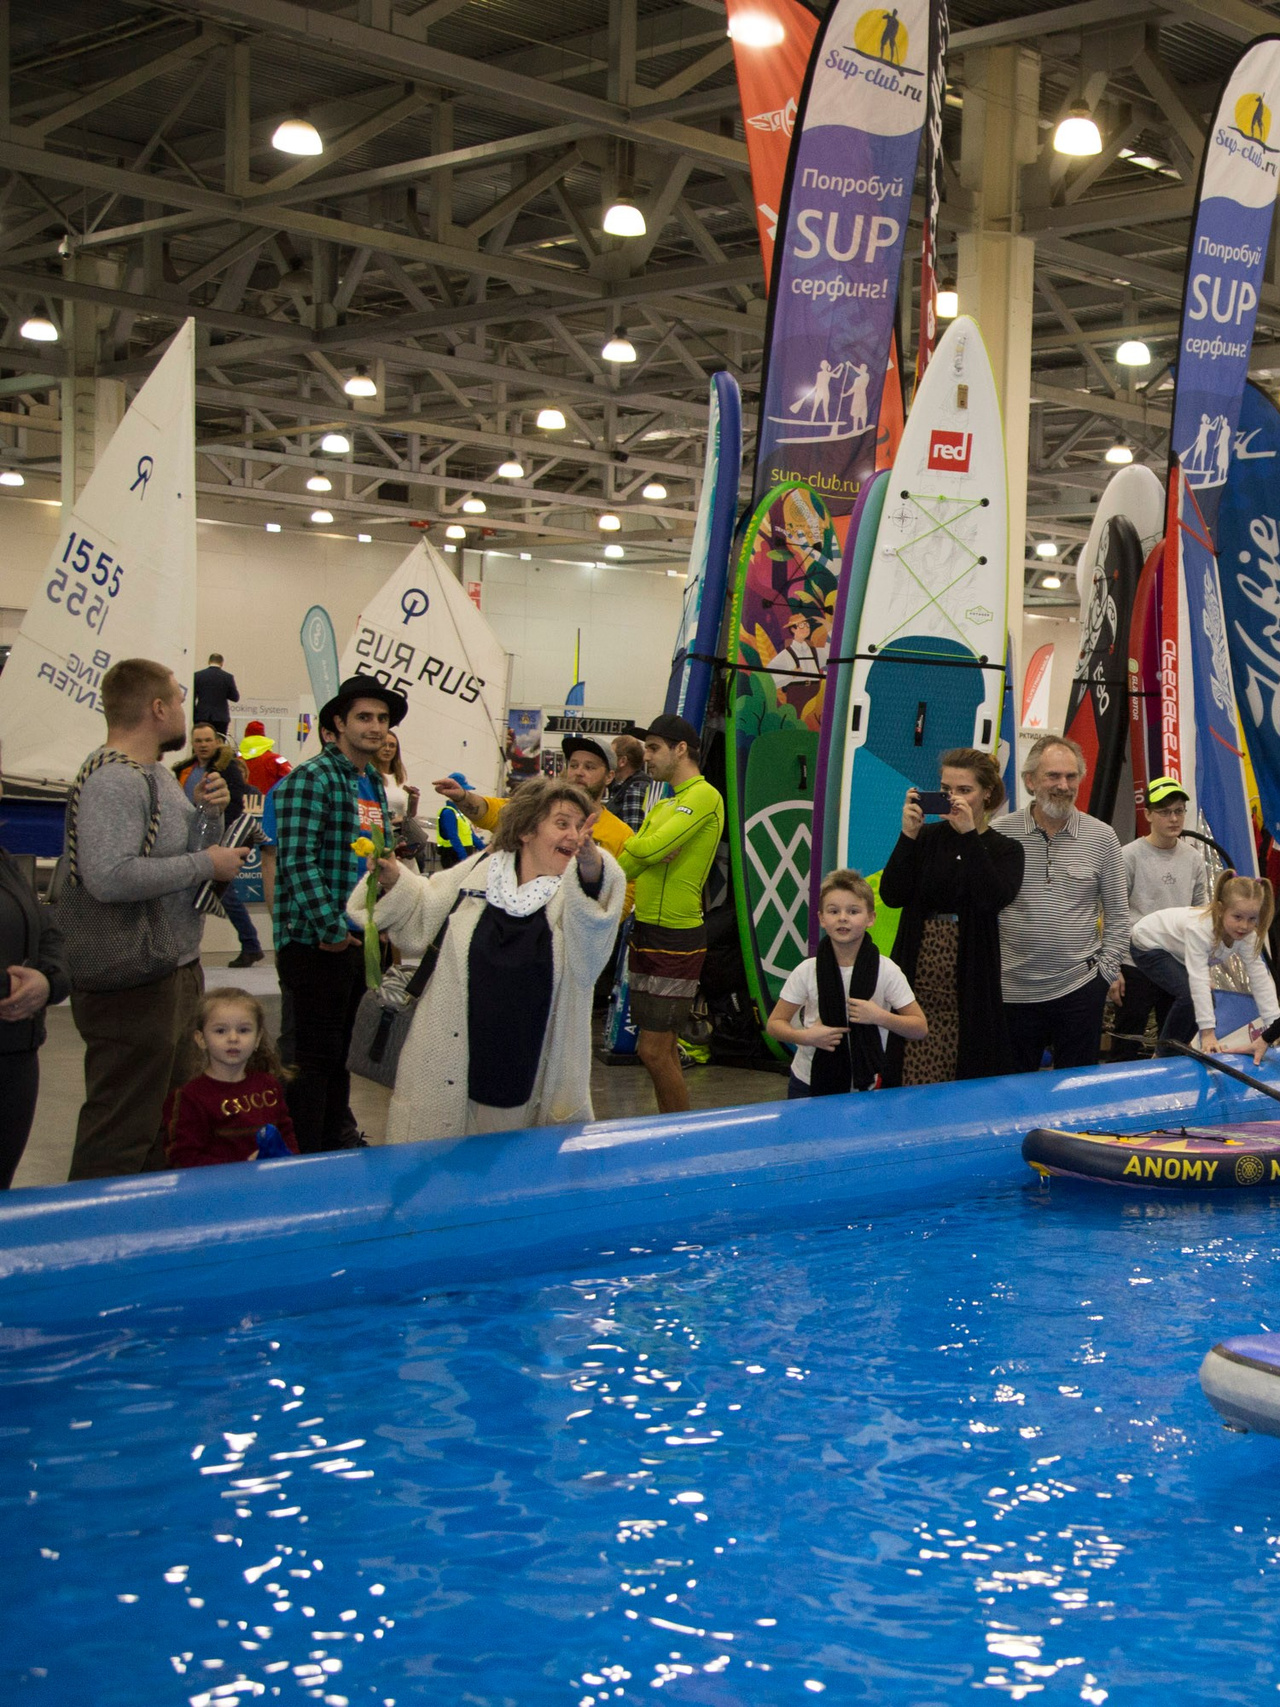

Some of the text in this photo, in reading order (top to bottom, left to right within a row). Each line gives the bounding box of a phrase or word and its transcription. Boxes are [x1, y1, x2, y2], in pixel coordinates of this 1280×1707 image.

[825, 49, 922, 102] Sup-club.ru
[801, 168, 904, 201] Попробуй
[793, 209, 900, 264] SUP
[1197, 236, 1263, 268] Попробуй
[791, 275, 889, 302] серфинг!
[1189, 273, 1257, 326] SUP
[933, 432, 969, 461] red
[770, 467, 860, 493] sup-club.ru
[62, 532, 124, 598] 1555
[418, 656, 486, 703] RUS
[229, 705, 258, 714] ooking
[1131, 675, 1139, 721] GLAIATOR
[557, 717, 628, 734] ШКИПЕР
[221, 1088, 279, 1116] GUCC
[1122, 1154, 1219, 1182] ANOMY
